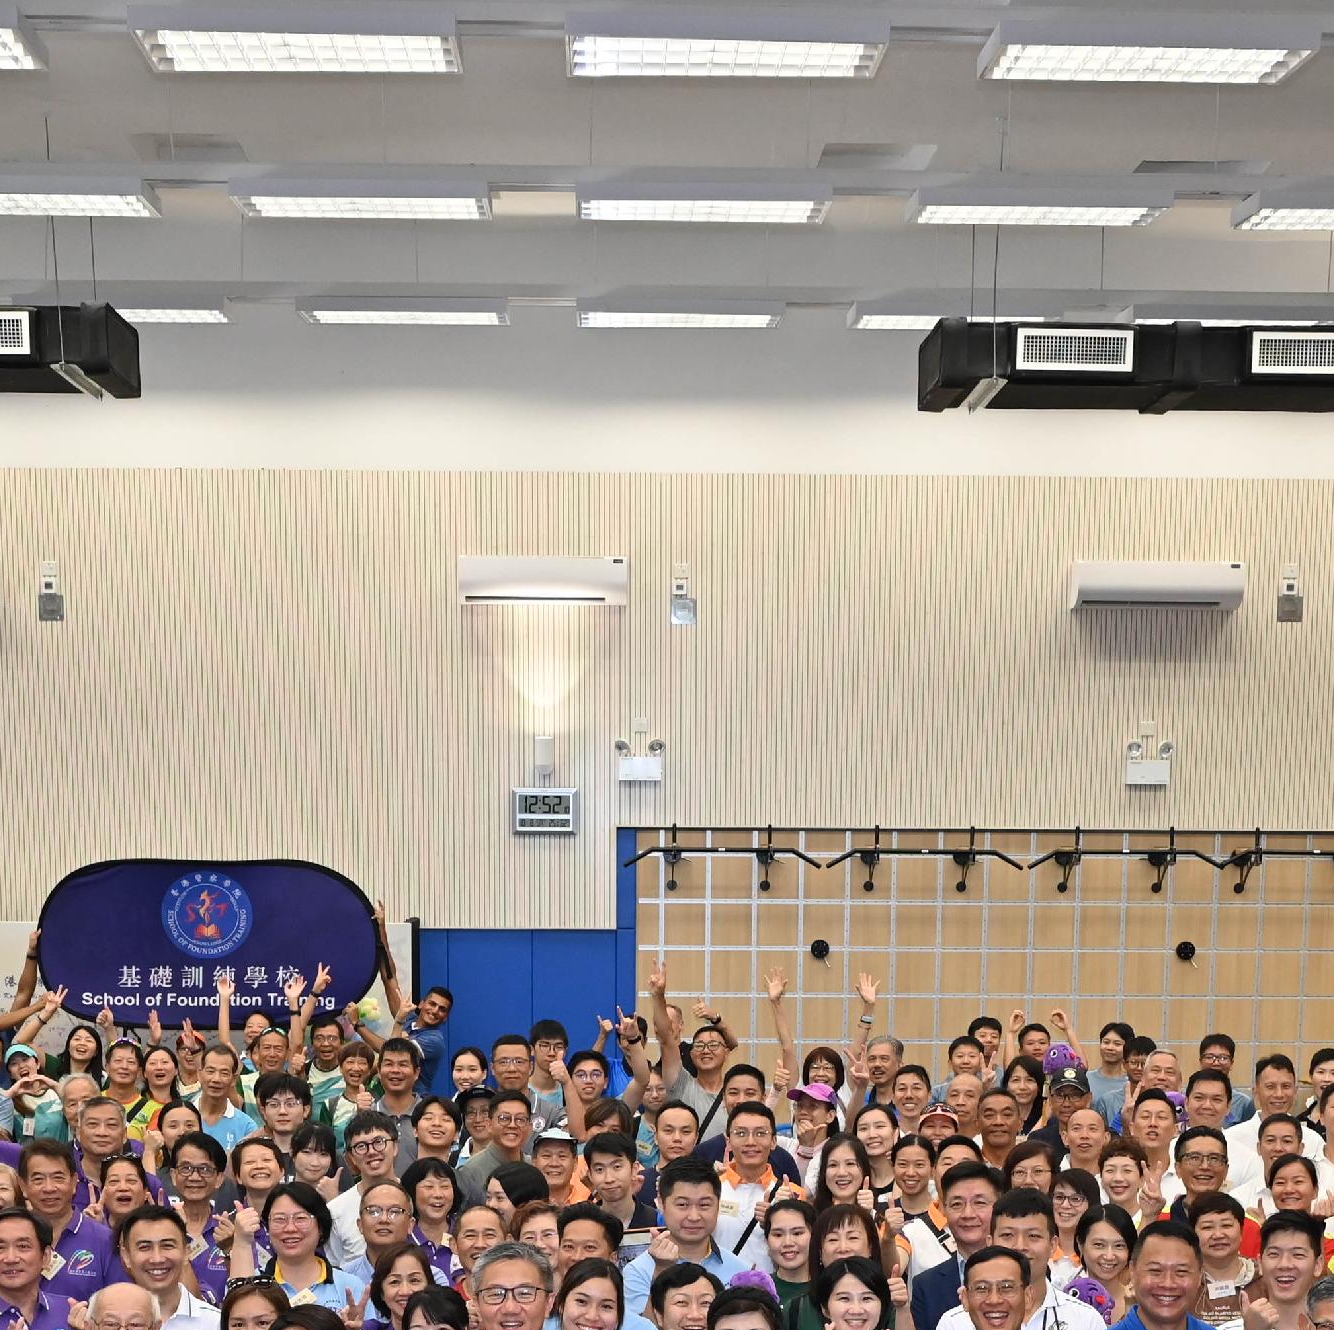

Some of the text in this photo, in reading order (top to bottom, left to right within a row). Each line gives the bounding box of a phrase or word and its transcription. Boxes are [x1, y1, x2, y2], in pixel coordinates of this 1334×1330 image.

[525, 795, 561, 813] 12:52
[187, 940, 235, 955] FOUNDATION
[234, 908, 247, 942] TRAINING
[81, 992, 140, 1007] School
[145, 992, 163, 1007] of
[167, 992, 265, 1007] Foundtion
